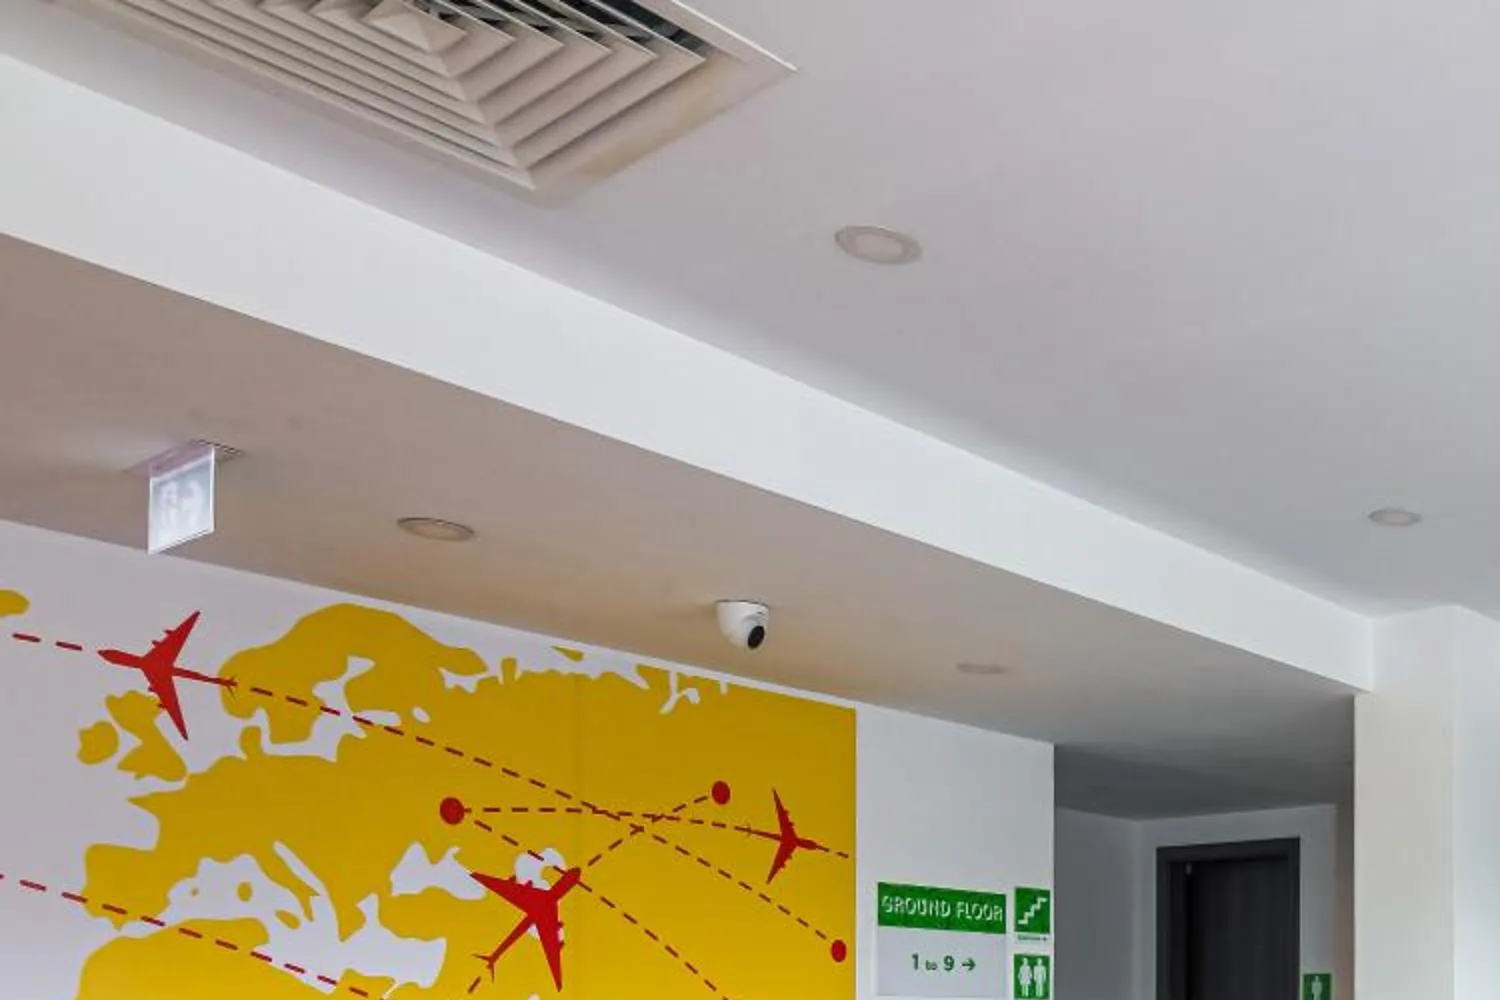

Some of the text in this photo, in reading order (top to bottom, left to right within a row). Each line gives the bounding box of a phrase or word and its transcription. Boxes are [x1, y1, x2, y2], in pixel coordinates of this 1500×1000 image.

[881, 896, 1003, 923] GROUND FLOOR
[911, 952, 955, 971] 1 to 9
